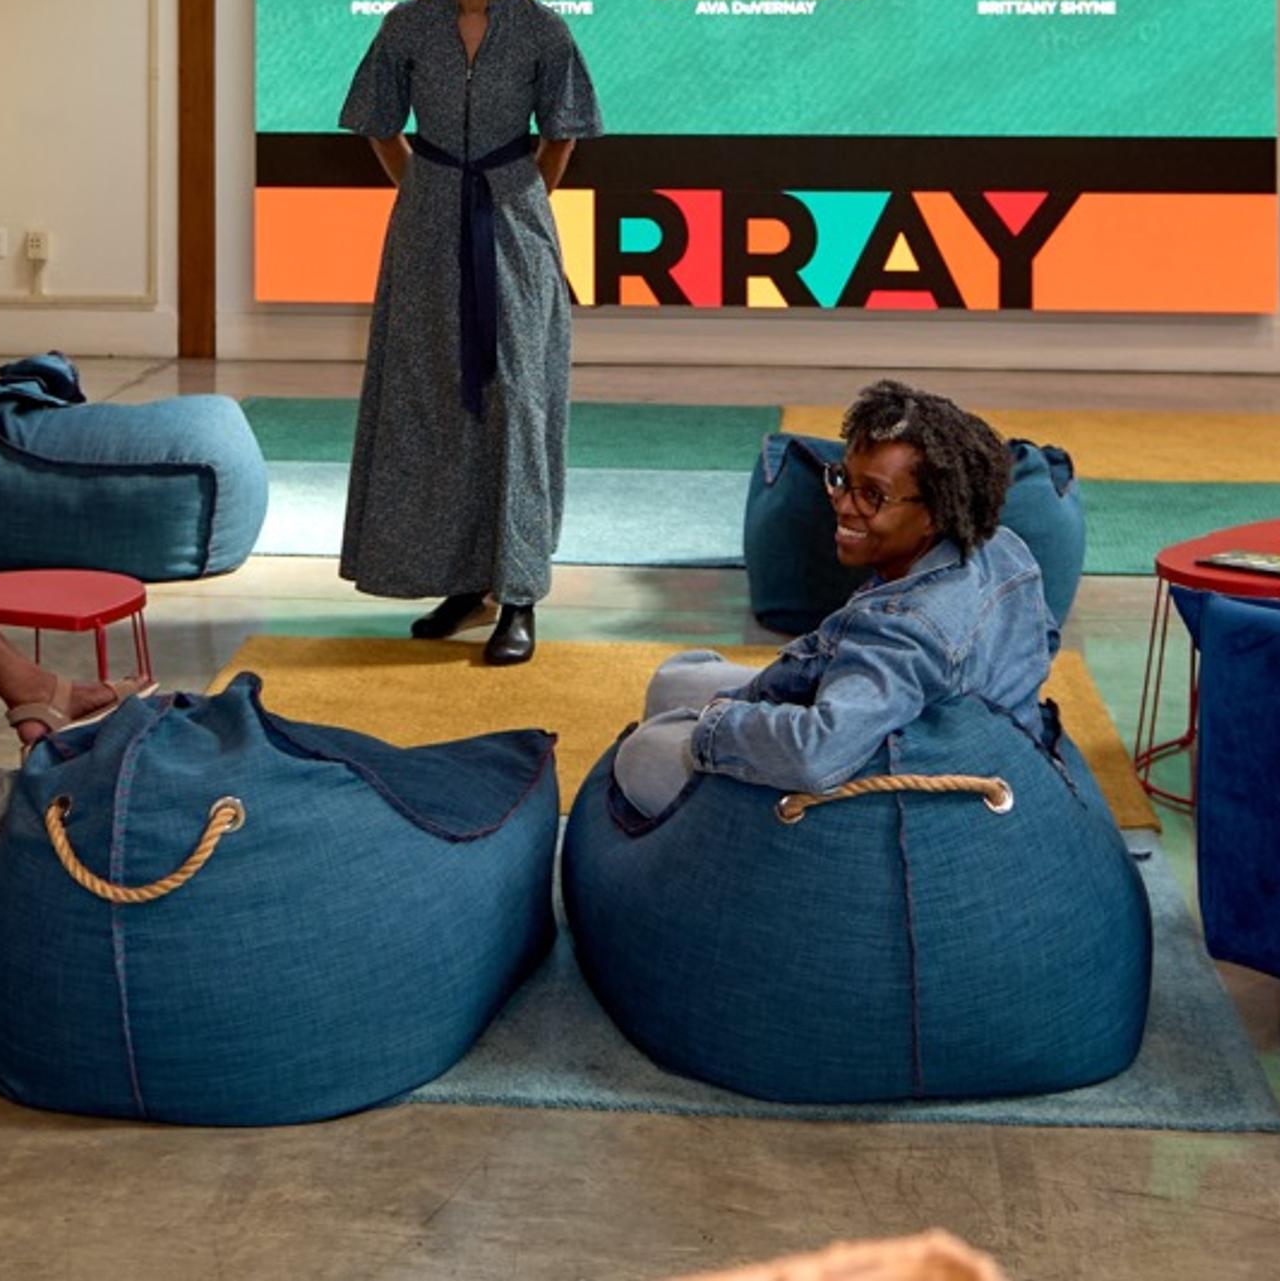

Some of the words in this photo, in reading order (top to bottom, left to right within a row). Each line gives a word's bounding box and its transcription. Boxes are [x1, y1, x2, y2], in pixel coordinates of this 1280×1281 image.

[695, 0, 730, 15] AVA
[977, 0, 1058, 15] BRITTANY
[566, 190, 1082, 310] RRAY
